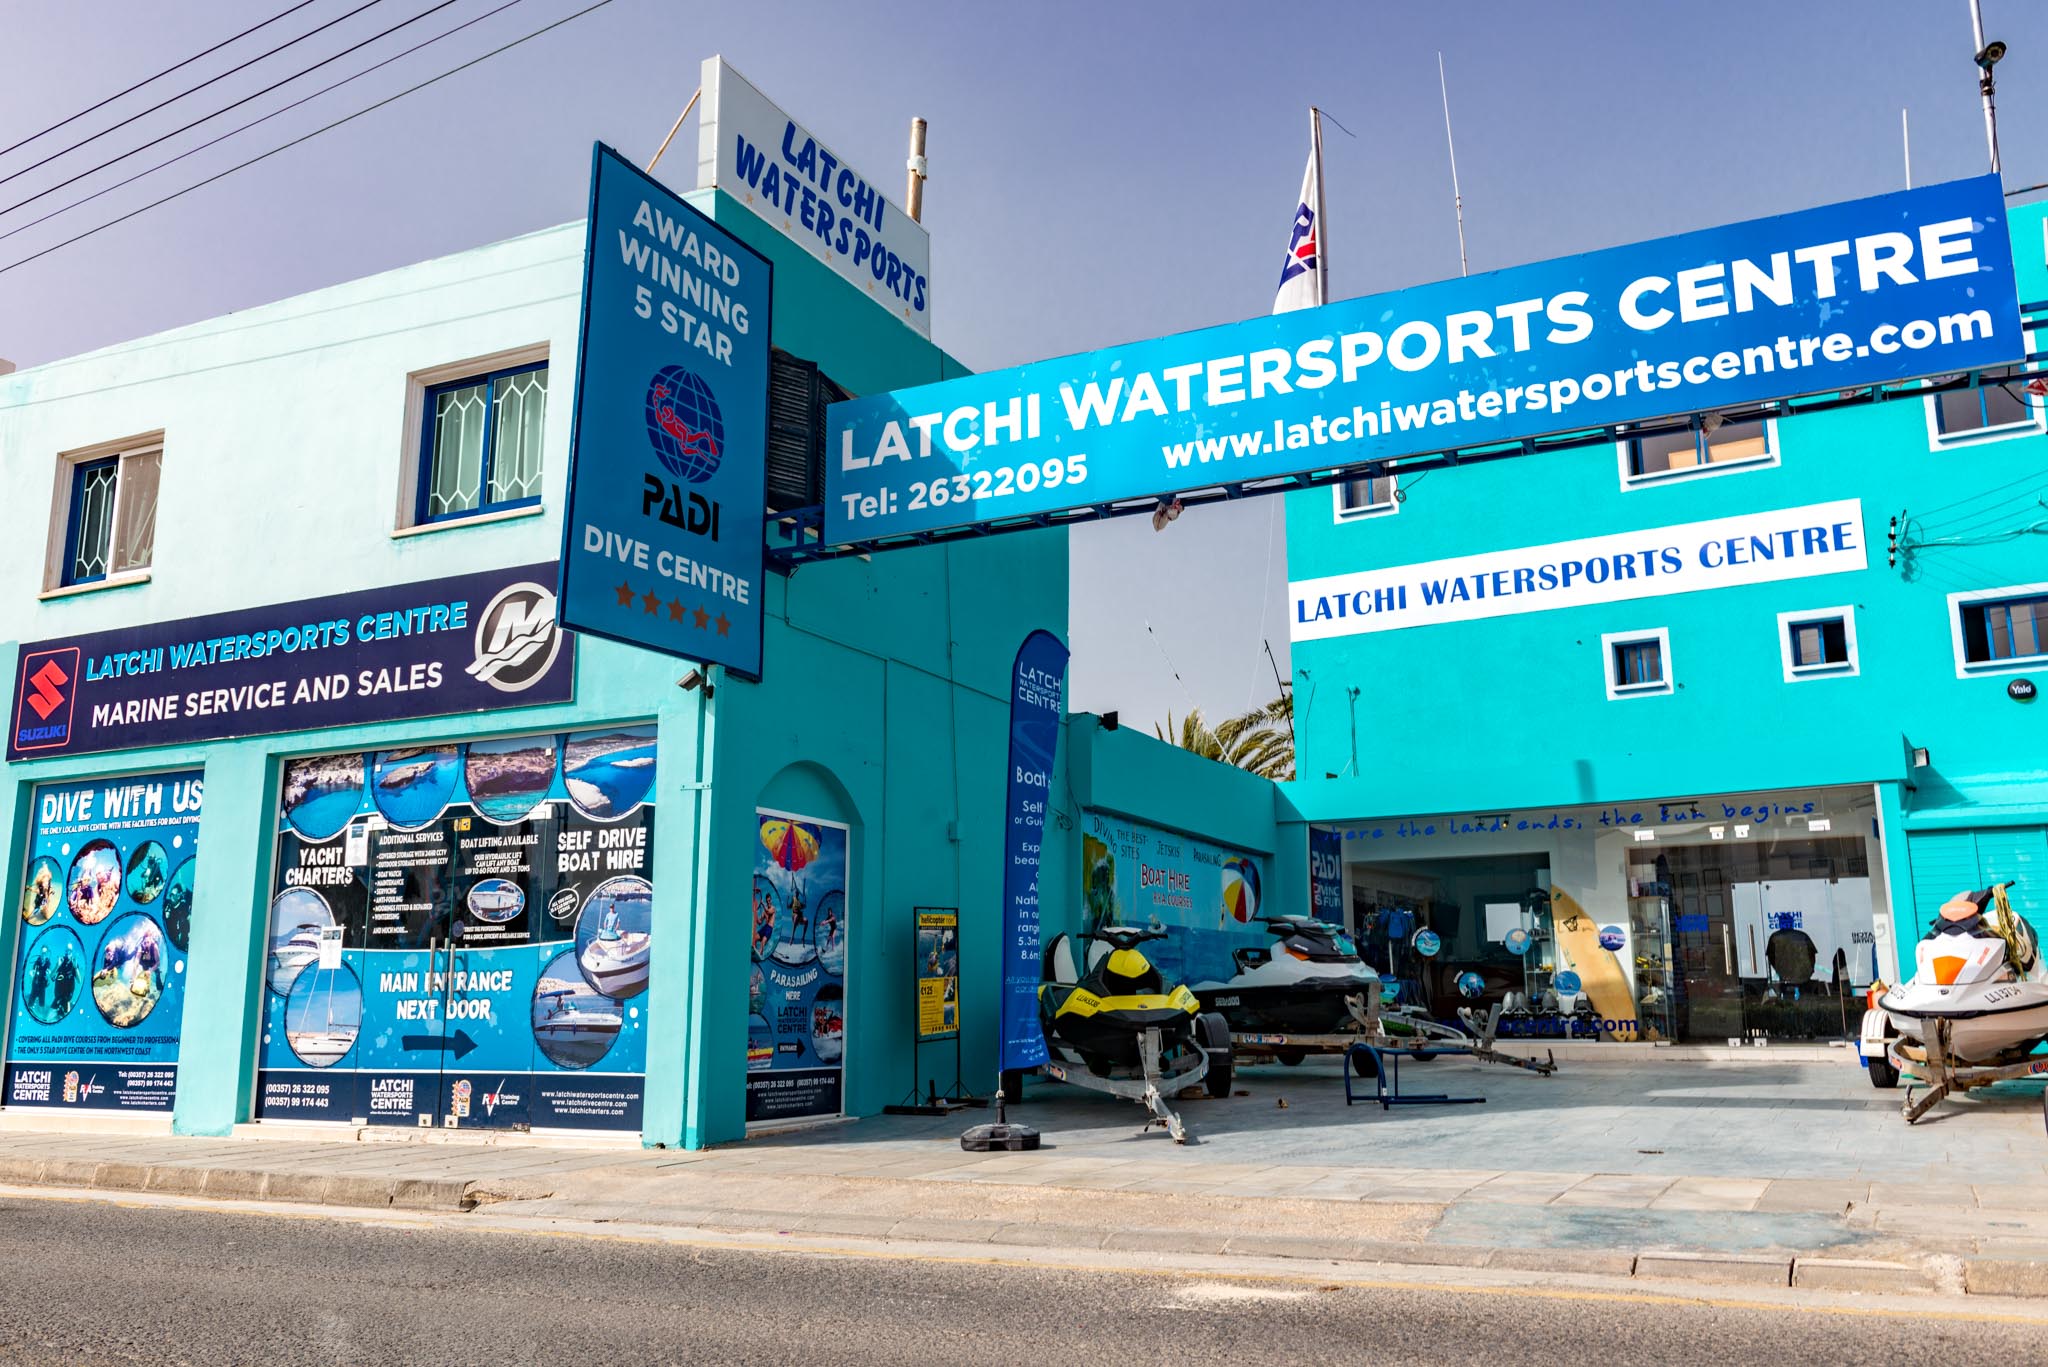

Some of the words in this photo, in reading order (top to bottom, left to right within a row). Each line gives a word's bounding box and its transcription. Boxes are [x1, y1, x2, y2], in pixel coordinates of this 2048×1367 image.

[782, 120, 885, 232] LATCHI
[736, 134, 926, 312] WATERSPORTS
[633, 200, 740, 287] AWARD
[618, 229, 749, 335] WINNING
[634, 284, 652, 319] 5
[661, 301, 733, 367] STAR
[842, 392, 1041, 472] LATCHI
[1059, 289, 1594, 431] WATERSPORTS
[1619, 216, 1980, 332] CENTRE
[1161, 309, 1995, 469] www.latchiwatersportscentre.com
[842, 487, 897, 520] Tel:
[908, 453, 1088, 509] 26322095
[643, 472, 720, 542] PADI
[584, 524, 649, 570] DIVE
[657, 550, 749, 605] CENTRE
[1297, 586, 1407, 624] LATCHI
[1421, 546, 1683, 605] WATERSPORTS
[1698, 521, 1857, 569] CENTRE
[86, 647, 163, 681] LATCHI
[169, 620, 350, 670] WATERSPORTS
[356, 600, 468, 642] CENTRE
[92, 695, 179, 728] MARINE
[184, 681, 287, 718] SERVICE
[292, 674, 350, 704] AND
[357, 662, 443, 696] SALES
[2012, 684, 2031, 694] Yale
[1018, 686, 1061, 713] CENTRE
[19, 724, 66, 742] SUZUKI
[41, 789, 94, 824] DIVE
[104, 783, 163, 819] WITH
[173, 779, 203, 812] US
[40, 827, 49, 835] THE
[50, 826, 62, 835] ONLY
[63, 825, 77, 833] LOCAL
[78, 824, 90, 832] DIVE
[90, 823, 108, 831] CENTRE
[122, 821, 132, 829] THE
[132, 819, 157, 828] FACILITIES
[158, 818, 168, 826] FOR
[168, 817, 182, 825] BOAT
[1014, 816, 1022, 825] or
[1396, 821, 1436, 838] the
[1450, 817, 1503, 834] land
[1517, 815, 1583, 831] ends,
[1598, 810, 1644, 827] the
[1660, 804, 1707, 822] fun
[1722, 802, 1816, 823] begins
[379, 834, 414, 845] ADDITIONAL
[415, 832, 444, 843] SERVICES
[461, 839, 478, 848] BOAT
[479, 837, 502, 847] LIFTING
[503, 835, 539, 846] AVAILABLE
[558, 831, 592, 851] SELF
[599, 827, 646, 848] DRIVE
[1094, 817, 1117, 853] DIVING
[1117, 829, 1130, 843] THE
[300, 847, 343, 866] YACHT
[1121, 847, 1140, 860] SITES
[1157, 841, 1180, 858] JETSKIS
[558, 851, 599, 872] BOAT
[607, 849, 644, 869] HIRE
[1311, 850, 1341, 880] PADI
[285, 866, 353, 885] CHARTERS
[1141, 863, 1166, 889] BOAT
[1168, 868, 1191, 892] HIRE
[1167, 893, 1193, 909] COURSES
[921, 915, 945, 926] helicopter
[1019, 909, 1029, 919] in
[380, 973, 418, 993] MAIN
[770, 968, 818, 988] PARASAILING
[397, 1000, 438, 1020] NEXT
[446, 999, 491, 1020] DOOR
[778, 1006, 807, 1017] LATCHI
[778, 1023, 807, 1034] CENTRE
[15, 1071, 51, 1083] LATCHI
[371, 1079, 414, 1091] LATCHI
[13, 1090, 49, 1100] CENTRE
[266, 1083, 291, 1096] (00357)
[292, 1084, 301, 1093] 26
[302, 1084, 316, 1093] 322
[316, 1086, 330, 1094] 095
[541, 1090, 639, 1100] www.latchiwatersportscentre.com
[265, 1096, 290, 1108] (00357)
[291, 1097, 300, 1106] 99
[301, 1097, 314, 1107] 174
[315, 1098, 328, 1107] 443
[370, 1098, 413, 1110] CENTRE
[552, 1099, 628, 1107] www.latchidivecentre.com
[554, 1107, 624, 1115] www.latchicharters.com
